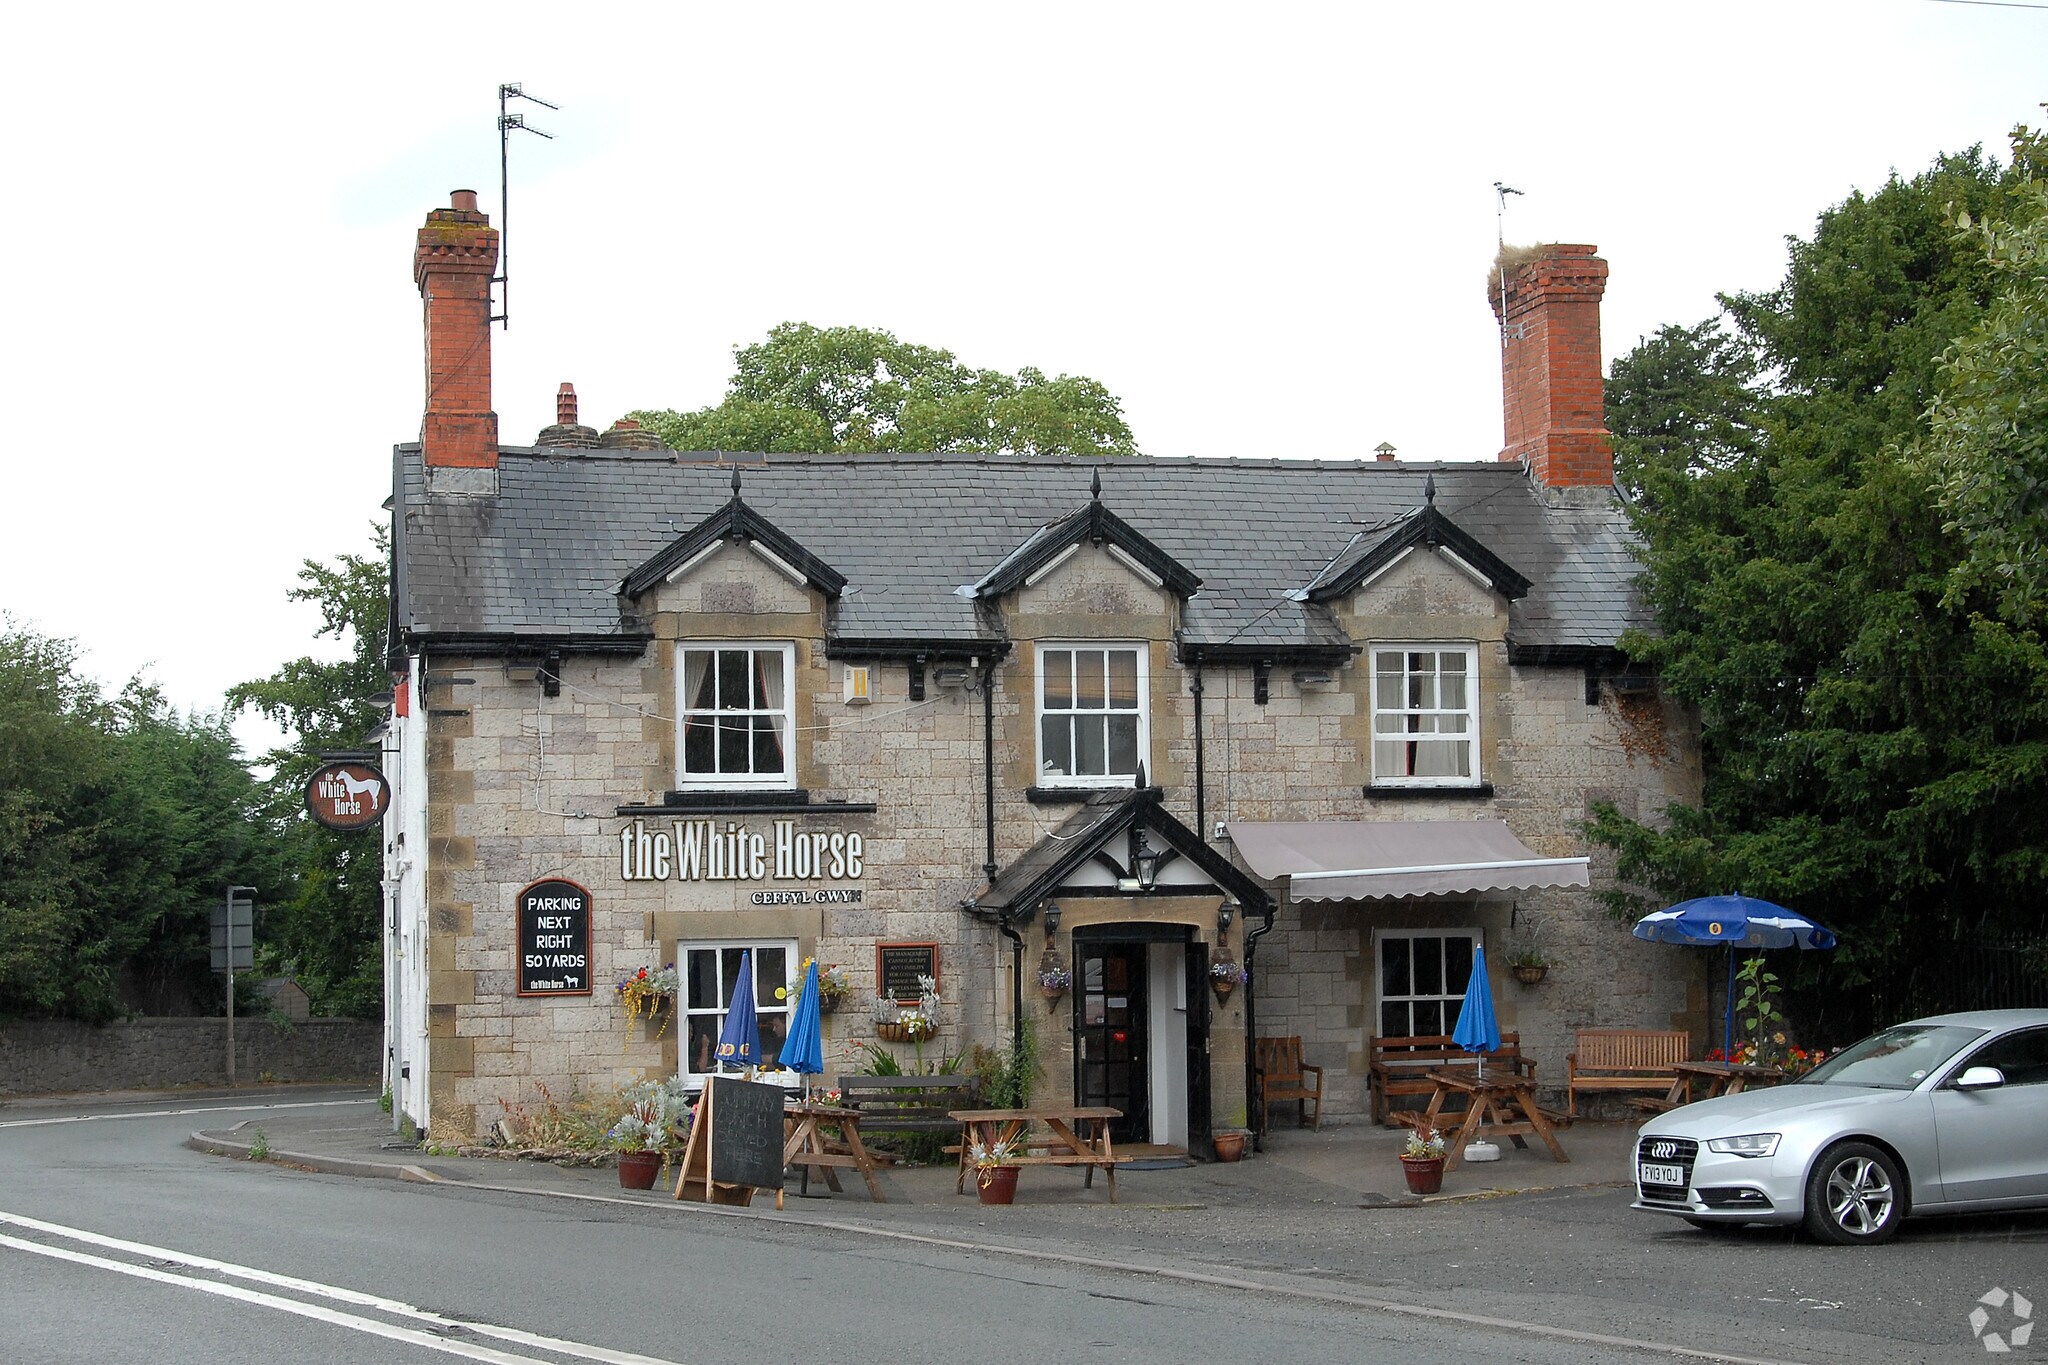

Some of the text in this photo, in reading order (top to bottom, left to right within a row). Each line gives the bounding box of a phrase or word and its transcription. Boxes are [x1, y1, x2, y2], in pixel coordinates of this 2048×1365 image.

[325, 772, 334, 781] the
[318, 781, 346, 799] White
[334, 799, 361, 816] Horse
[620, 819, 863, 881] the White Horse
[527, 897, 581, 911] PARKING
[751, 890, 811, 905] CEFFYL
[537, 916, 571, 929] NEXT
[536, 935, 573, 949] RIGHT
[525, 954, 585, 968] 50 YARDS
[537, 979, 551, 989] White
[551, 979, 564, 989] Horse
[1644, 1166, 1678, 1182] FY13 YOJ
